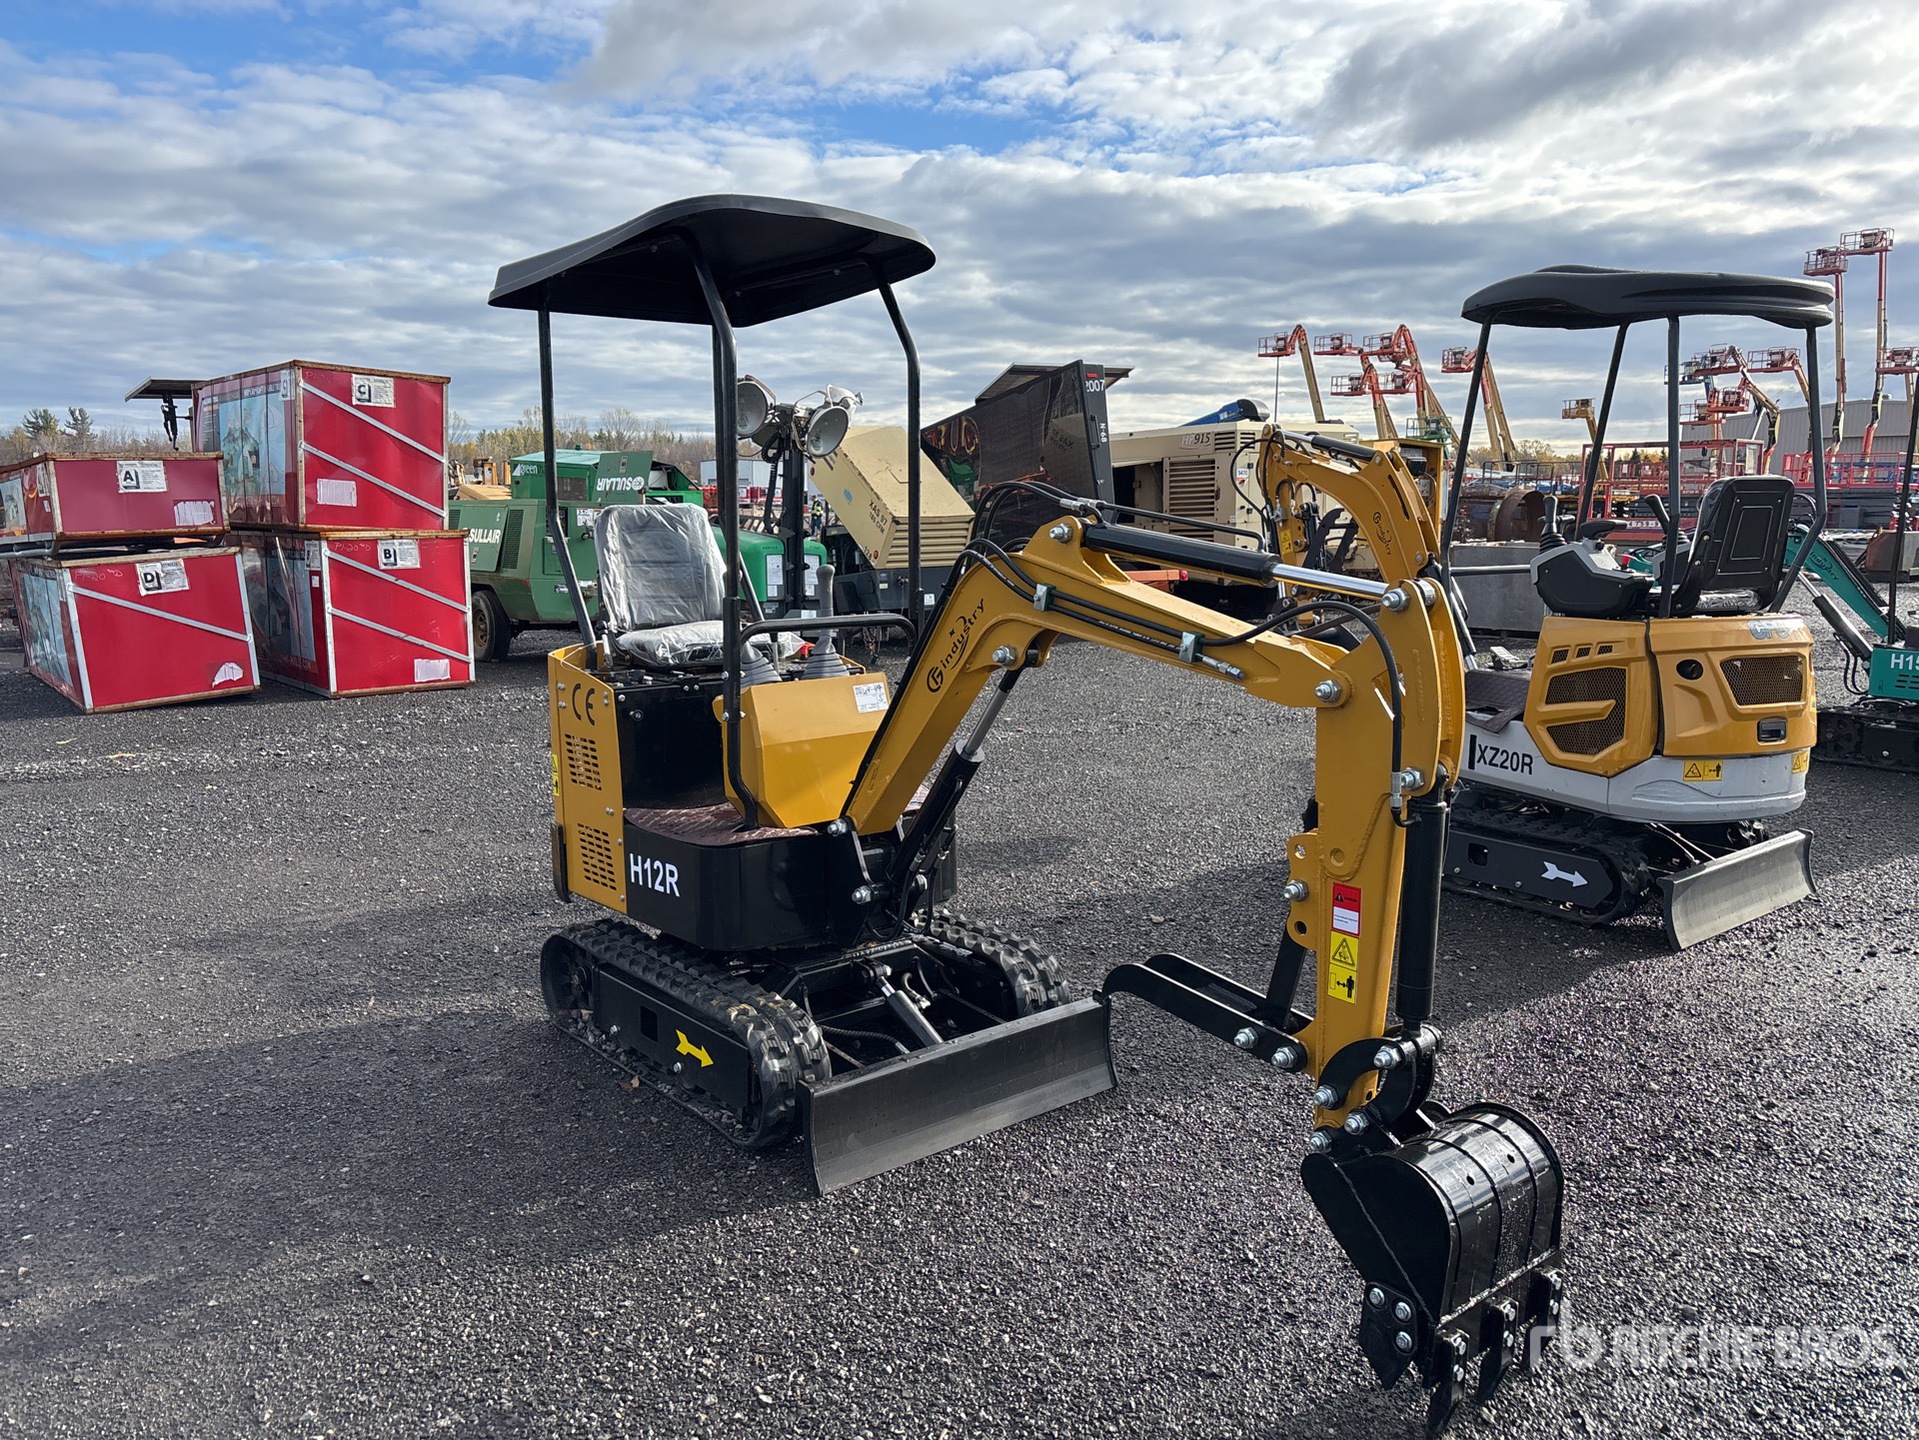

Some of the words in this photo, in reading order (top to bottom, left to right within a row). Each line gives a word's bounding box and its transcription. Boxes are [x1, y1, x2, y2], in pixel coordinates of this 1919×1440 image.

[357, 384, 367, 395] C
[123, 470, 134, 482] A
[596, 477, 633, 492] SULLAIR
[469, 528, 502, 544] SULLAIR
[383, 548, 392, 560] B
[143, 572, 155, 584] D
[572, 682, 596, 727] CE
[1476, 743, 1534, 775] XZ20R
[629, 852, 681, 898] H12R
